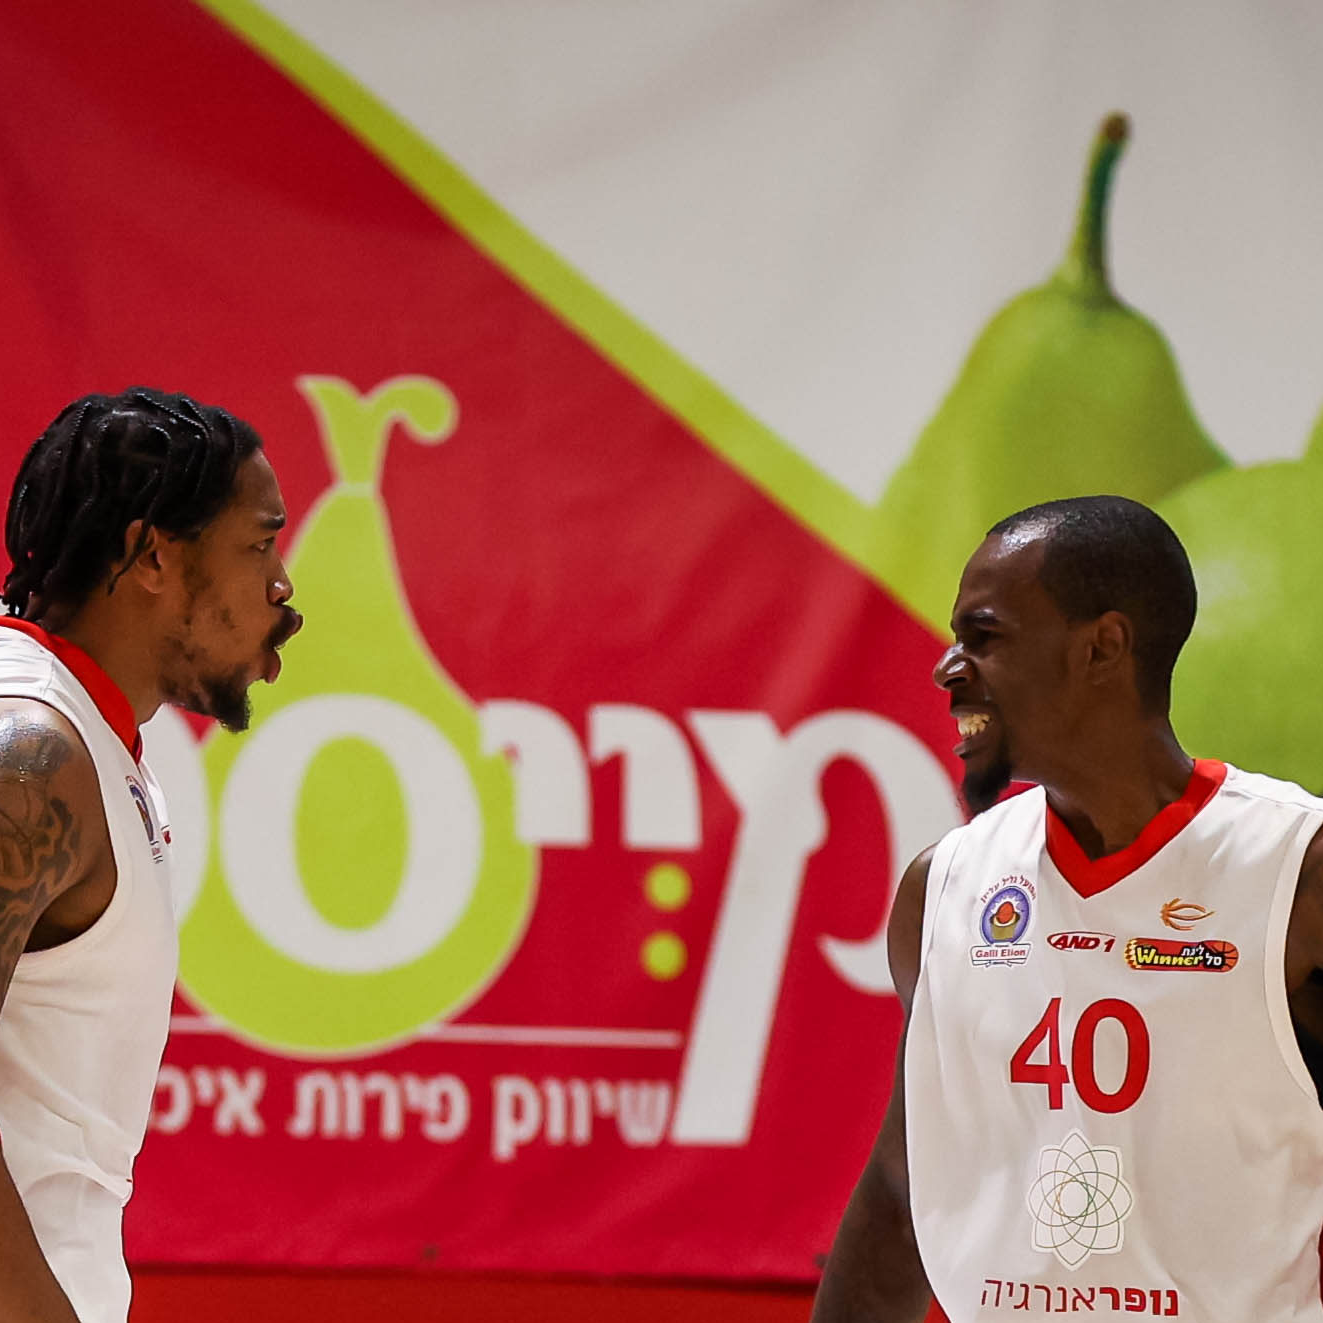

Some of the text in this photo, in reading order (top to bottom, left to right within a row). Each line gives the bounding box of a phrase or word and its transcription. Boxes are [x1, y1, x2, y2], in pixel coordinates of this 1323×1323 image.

[1052, 934, 1117, 953] AND 1
[1181, 944, 1205, 957] ליגת
[1136, 946, 1204, 967] Winner
[1205, 951, 1223, 967] סל
[1009, 996, 1151, 1114] 40
[148, 1064, 674, 1162] שיווק פירות איכ
